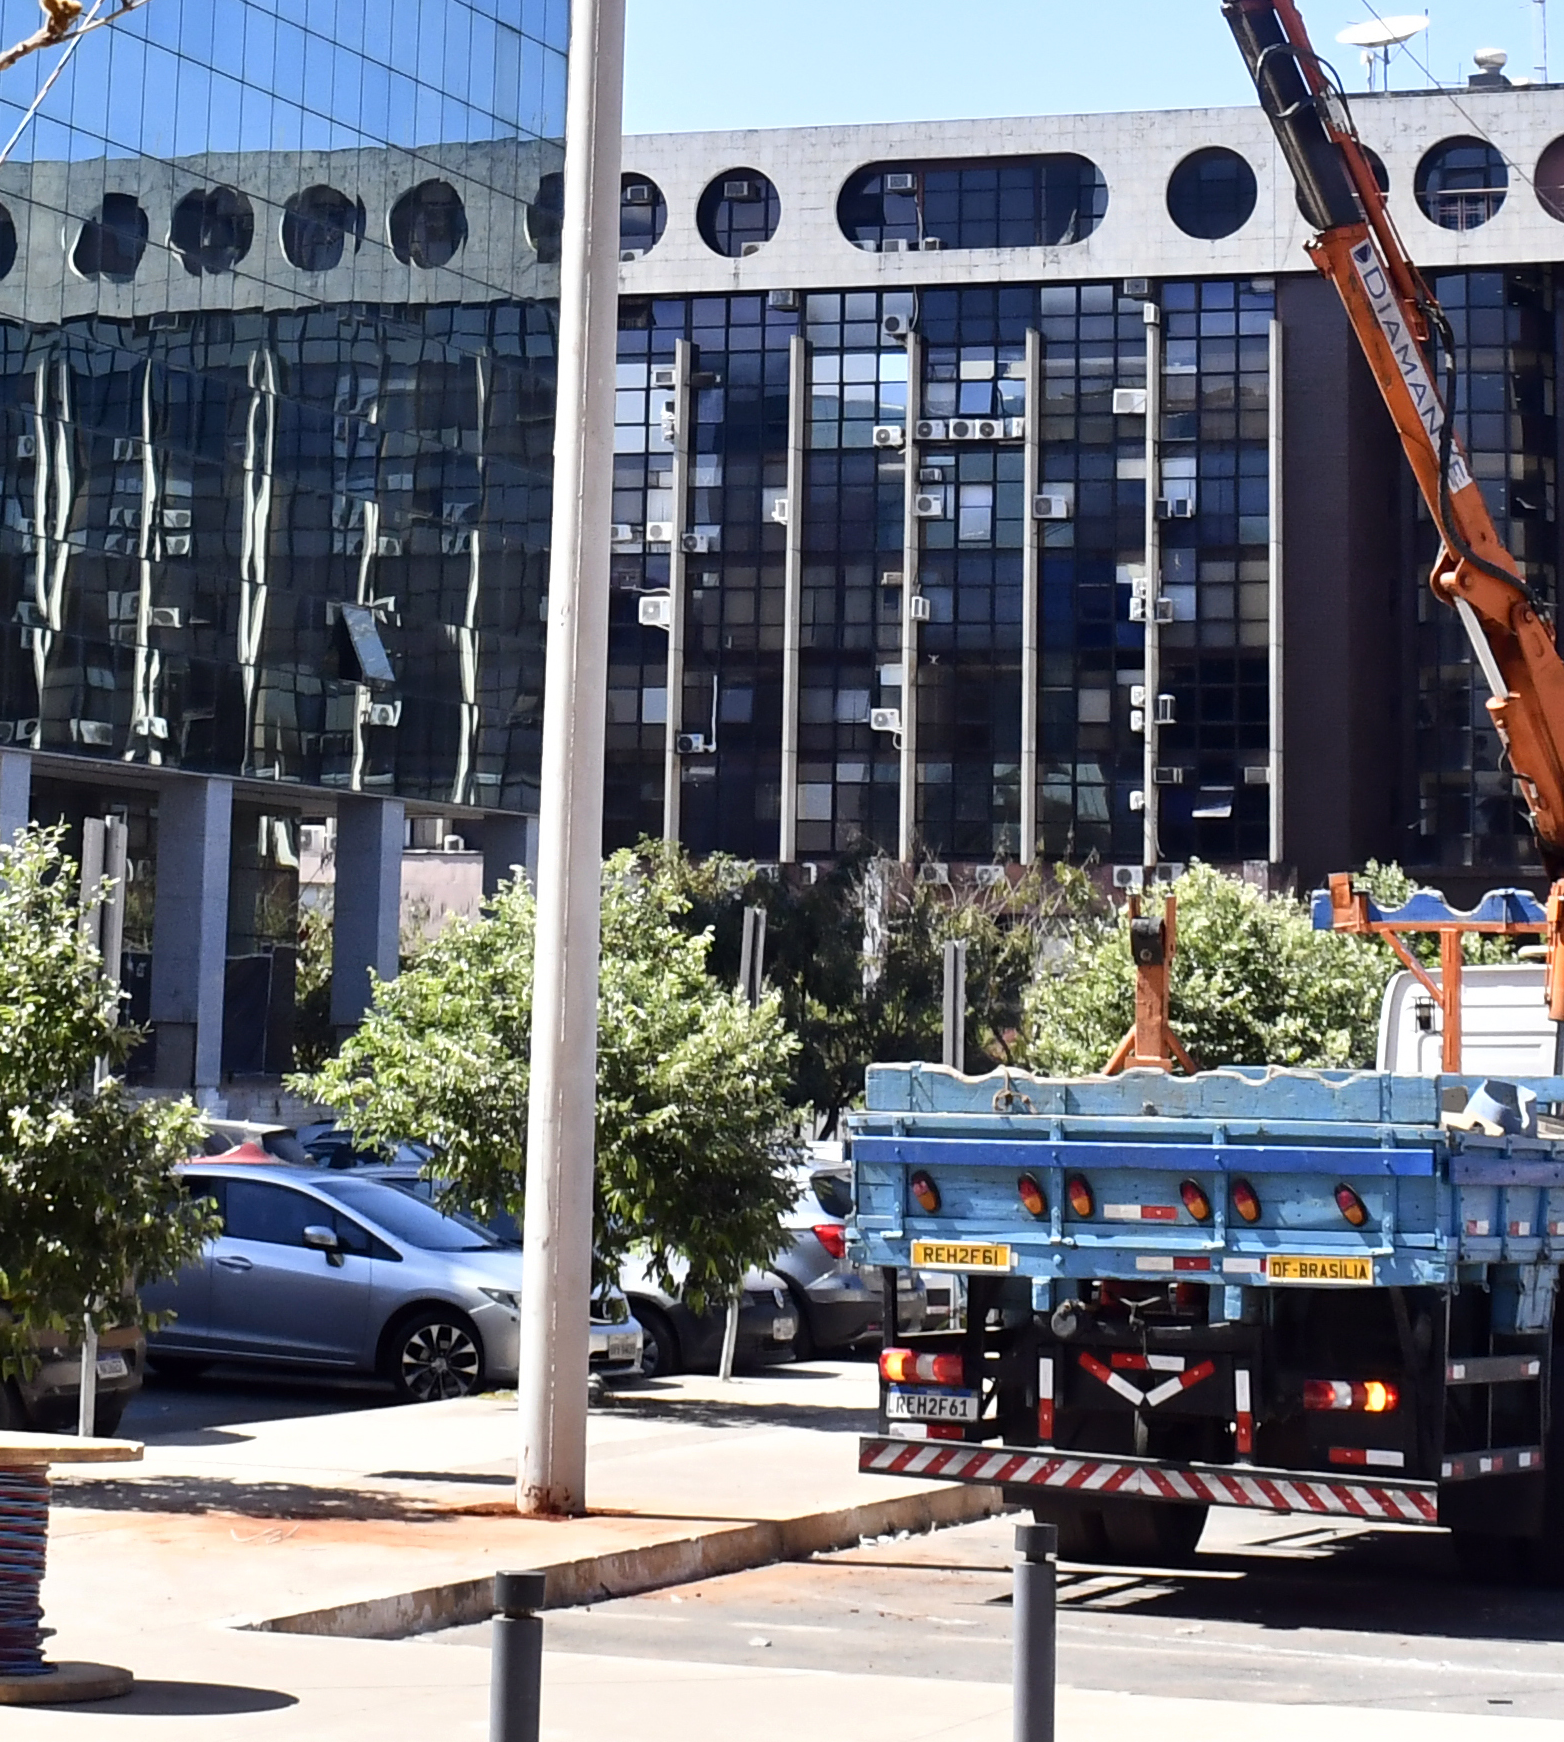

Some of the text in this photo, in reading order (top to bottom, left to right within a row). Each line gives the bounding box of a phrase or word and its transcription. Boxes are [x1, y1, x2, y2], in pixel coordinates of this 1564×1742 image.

[1362, 267, 1467, 487] DIAMANE
[922, 1246, 999, 1266] REH2F61
[895, 1395, 968, 1418] REH2F61
